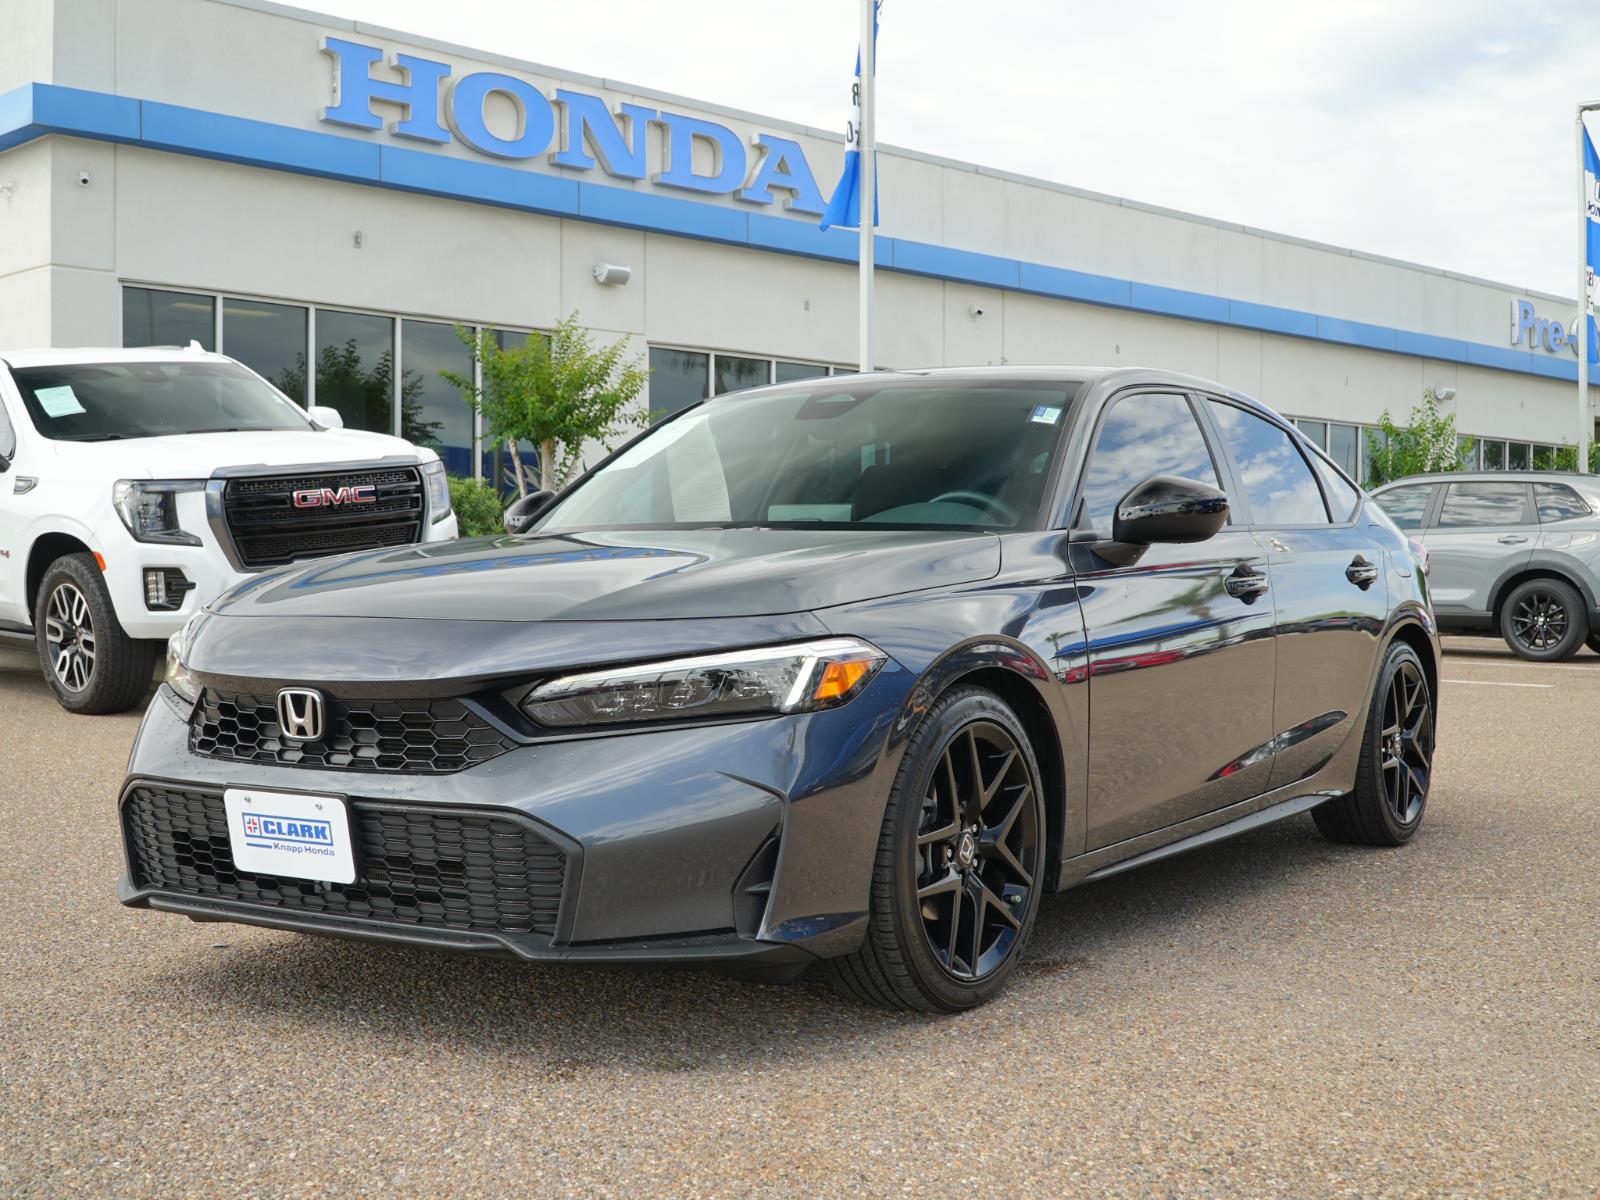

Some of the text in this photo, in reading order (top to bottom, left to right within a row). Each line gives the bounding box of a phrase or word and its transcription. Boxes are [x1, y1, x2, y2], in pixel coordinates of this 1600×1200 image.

[319, 37, 829, 216] HONDA
[293, 485, 376, 507] GMC
[263, 820, 328, 840] CLARK
[274, 843, 335, 856] Knapp Honda
